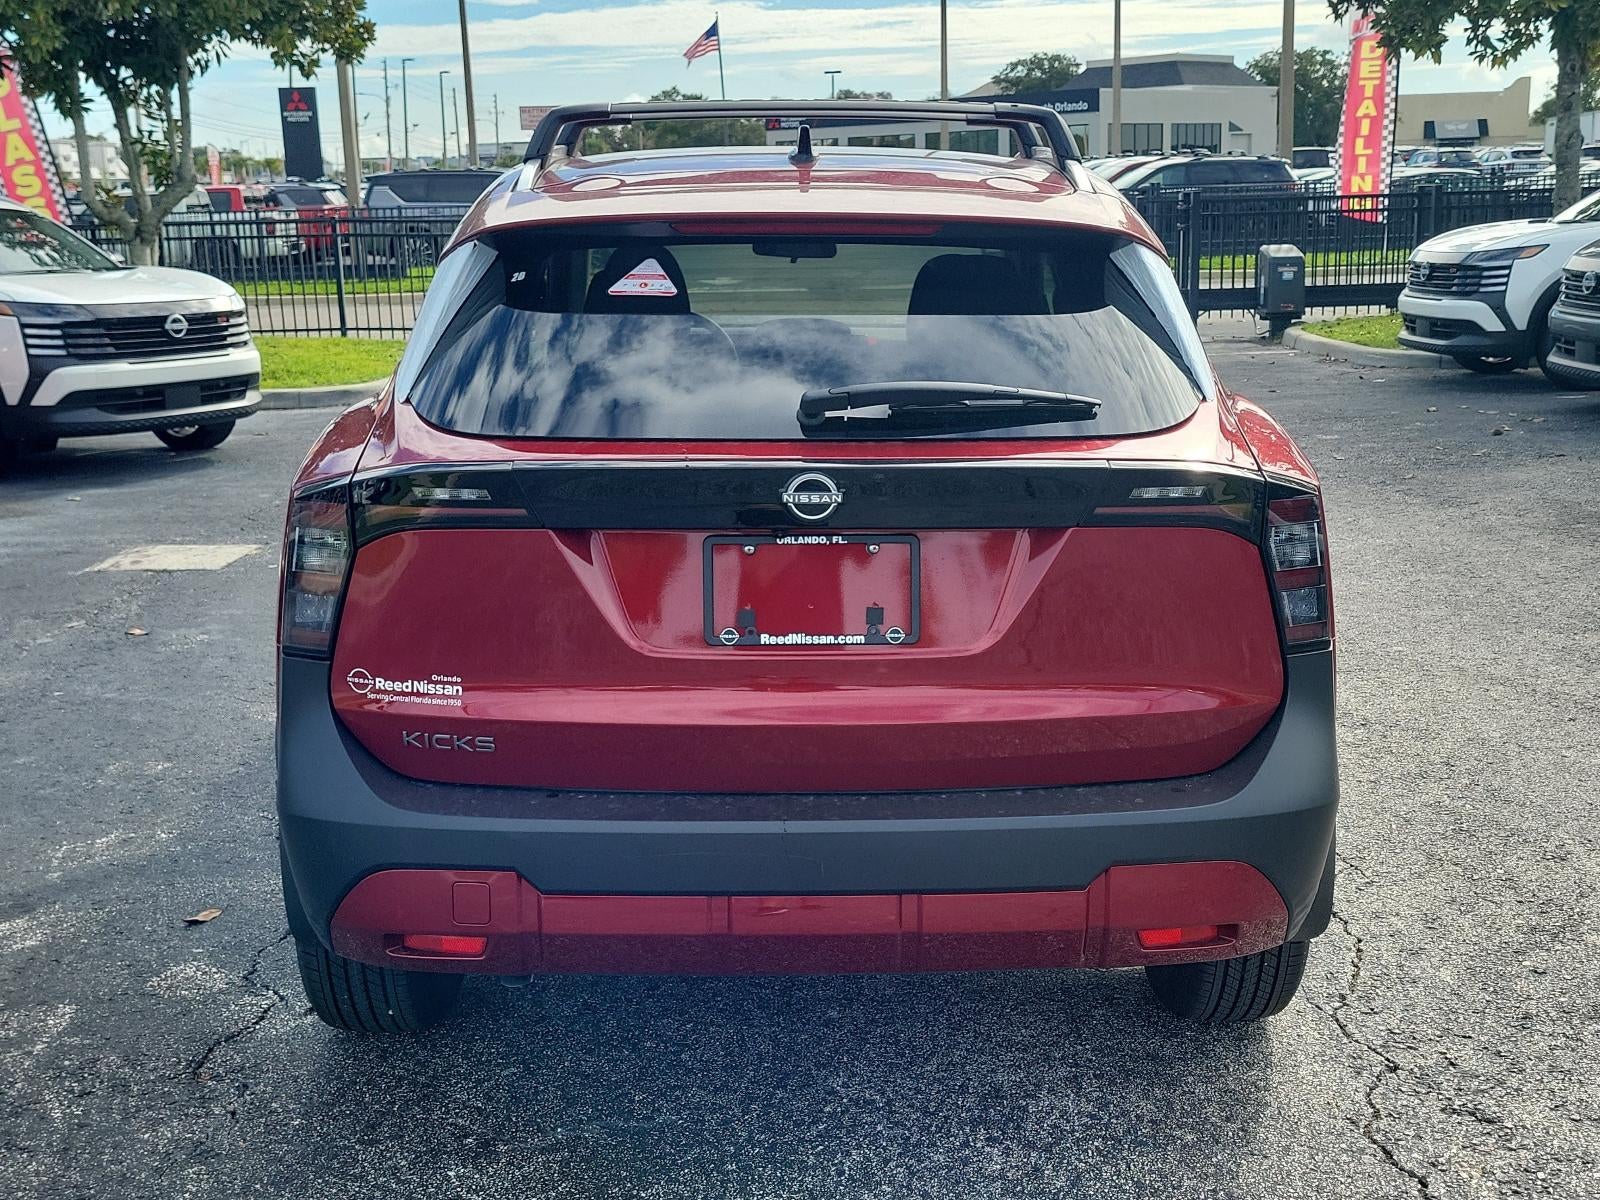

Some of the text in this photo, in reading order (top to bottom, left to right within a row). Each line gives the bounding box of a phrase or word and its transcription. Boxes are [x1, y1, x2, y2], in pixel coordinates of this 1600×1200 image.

[1055, 101, 1089, 111] Orlando
[783, 494, 842, 503] NISSAN
[776, 535, 848, 546] ORLANDO, FL.
[760, 633, 865, 645] ReedNissan.com
[346, 676, 375, 685] NISSAN
[431, 674, 462, 683] Orlando
[367, 691, 462, 707] Serving Central Florida since 1950
[402, 730, 496, 752] KICKS
